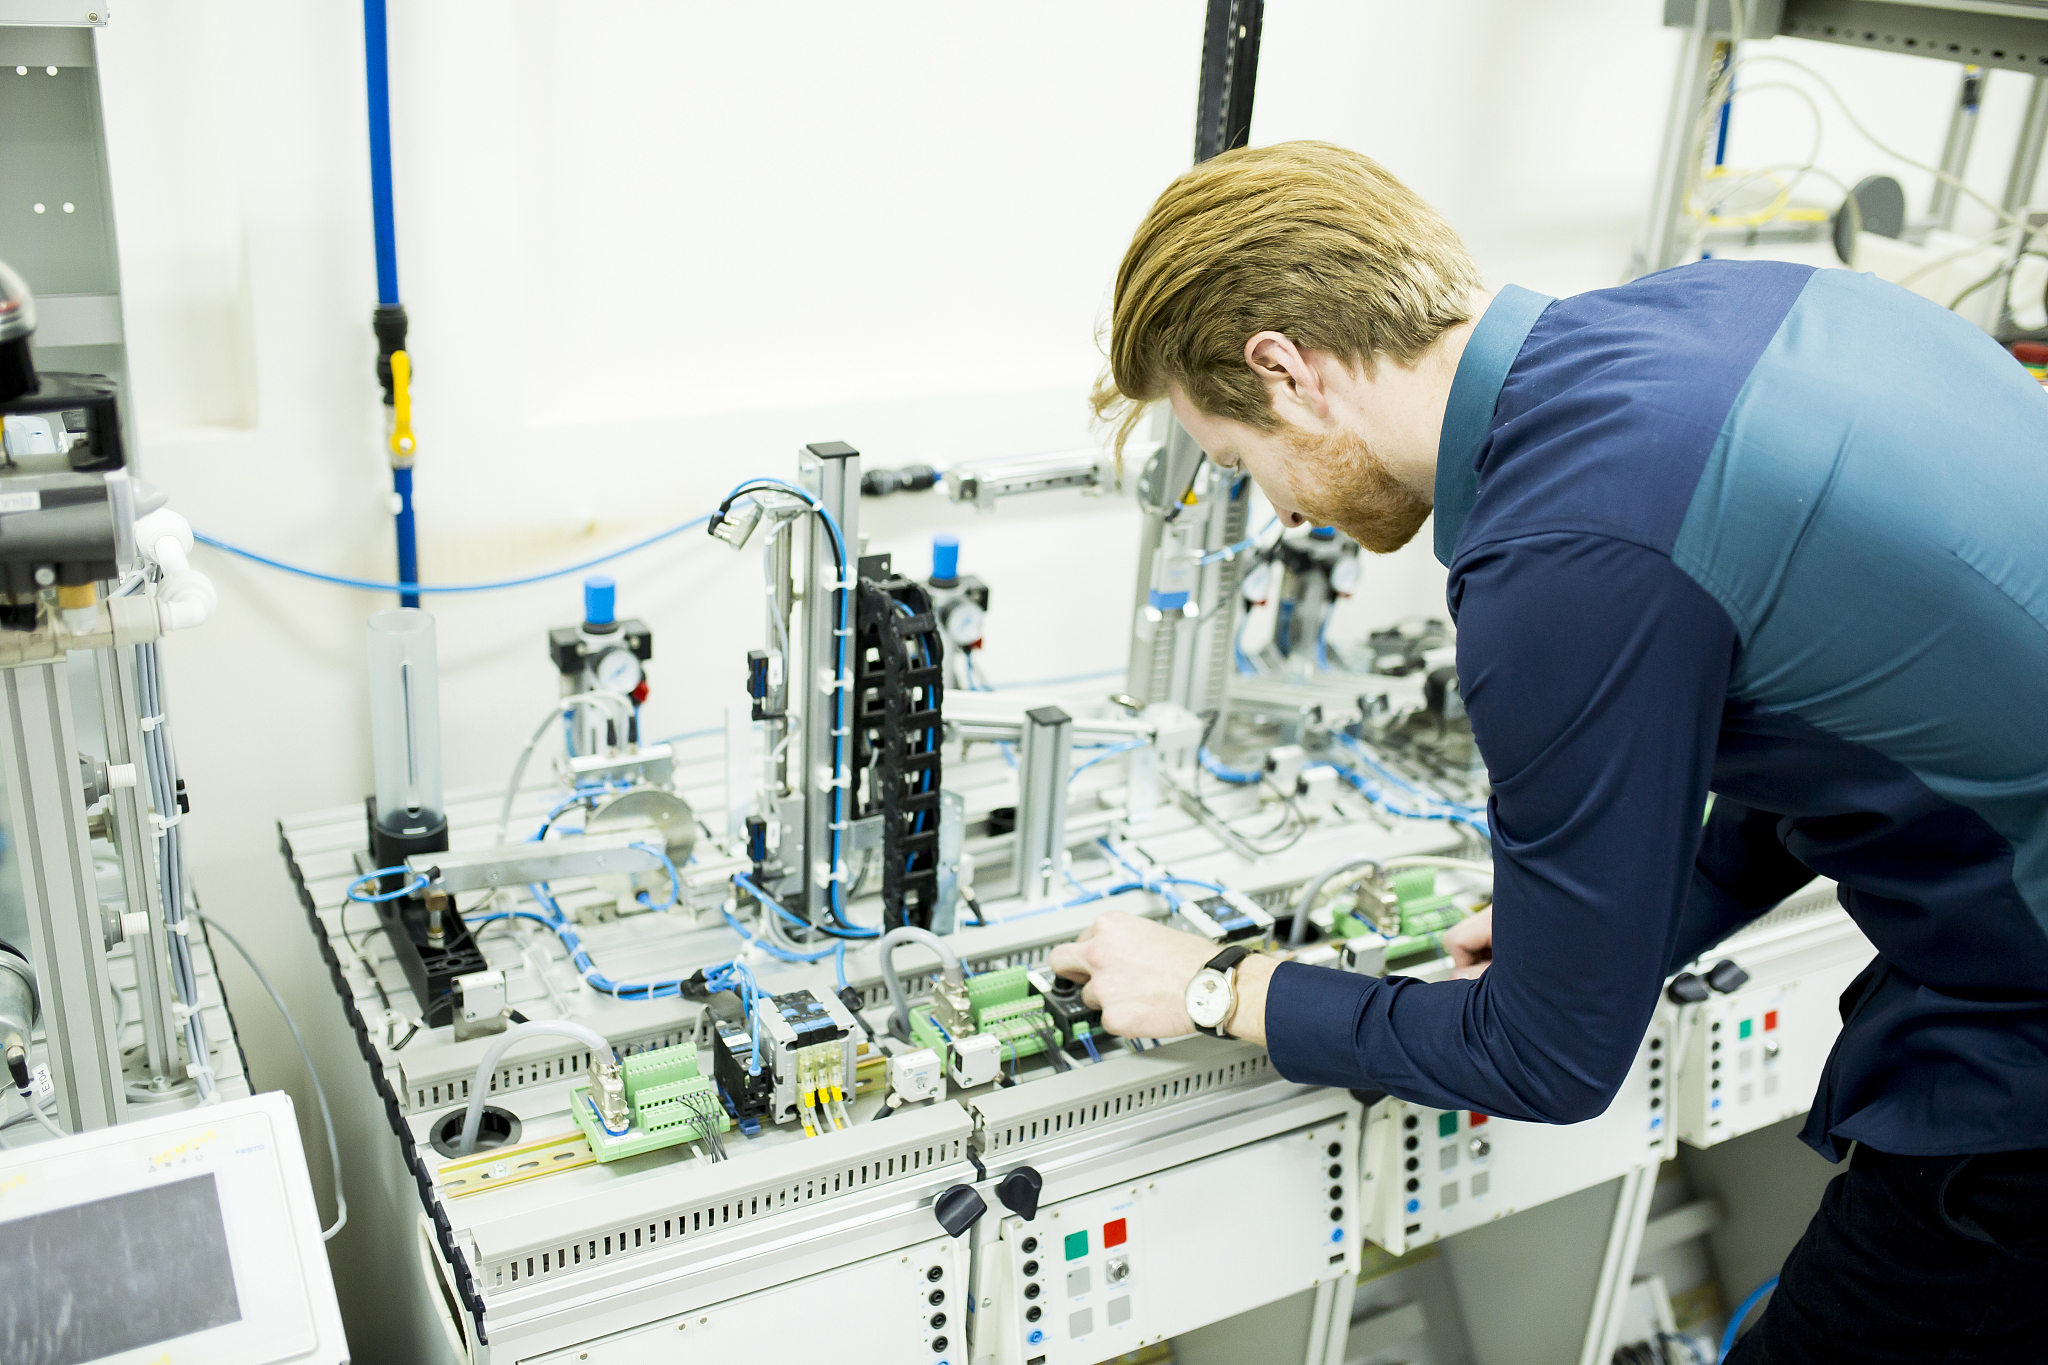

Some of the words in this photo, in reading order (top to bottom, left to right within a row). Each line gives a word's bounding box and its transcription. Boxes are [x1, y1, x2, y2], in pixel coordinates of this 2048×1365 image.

[37, 1069, 51, 1092] E104
[153, 1129, 218, 1165] REMOVE
[235, 1144, 265, 1155] FESTO
